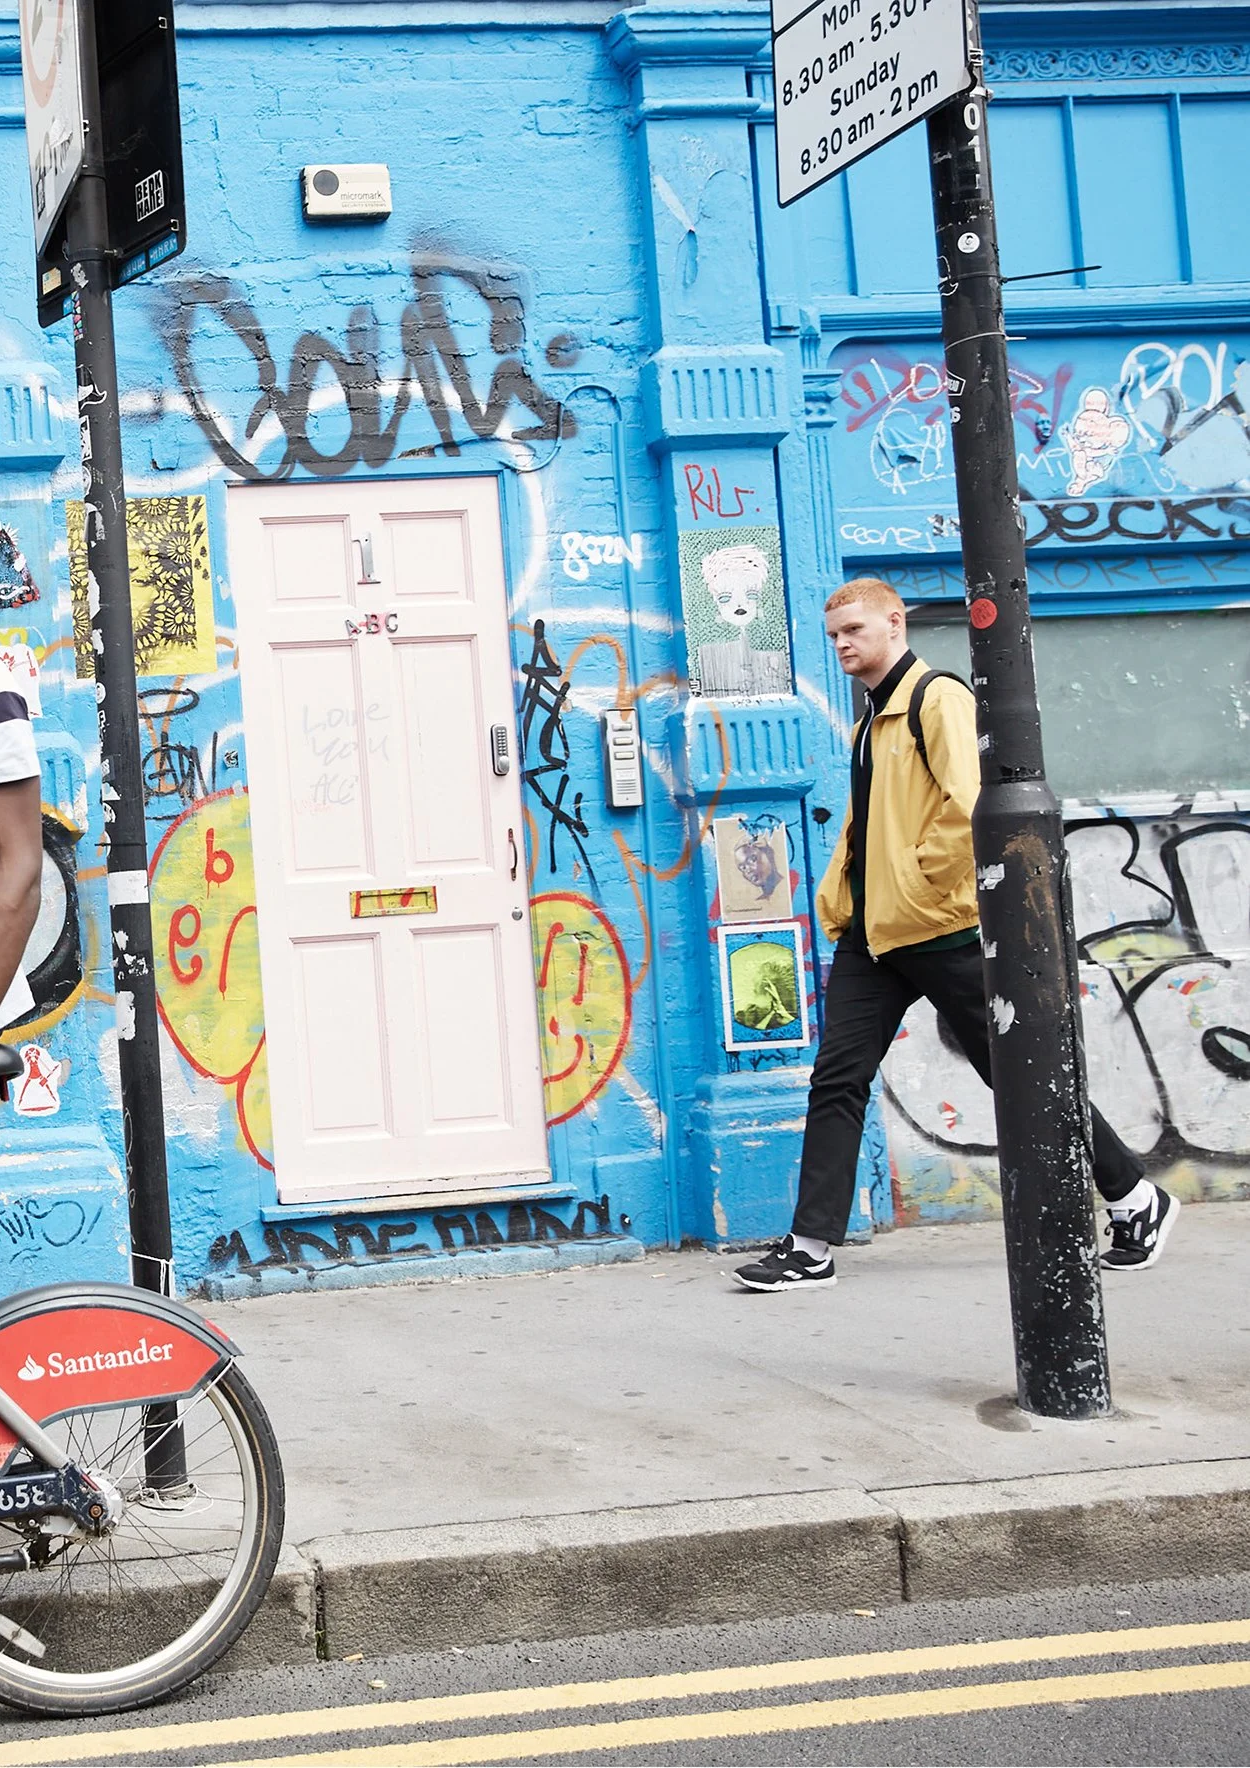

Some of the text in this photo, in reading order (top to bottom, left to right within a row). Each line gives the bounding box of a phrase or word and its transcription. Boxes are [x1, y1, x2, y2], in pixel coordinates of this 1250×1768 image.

[822, 0, 861, 39] Mon
[782, 57, 824, 106] 8.30
[828, 39, 855, 74] am
[870, 0, 917, 43] 5.30
[829, 52, 901, 117] Sunday
[800, 127, 843, 176] 8.30
[847, 110, 875, 146] am
[890, 86, 902, 117] 2
[907, 69, 939, 111] pm
[340, 190, 386, 203] micromark
[351, 531, 381, 585] 1
[48, 1337, 173, 1377] Santander
